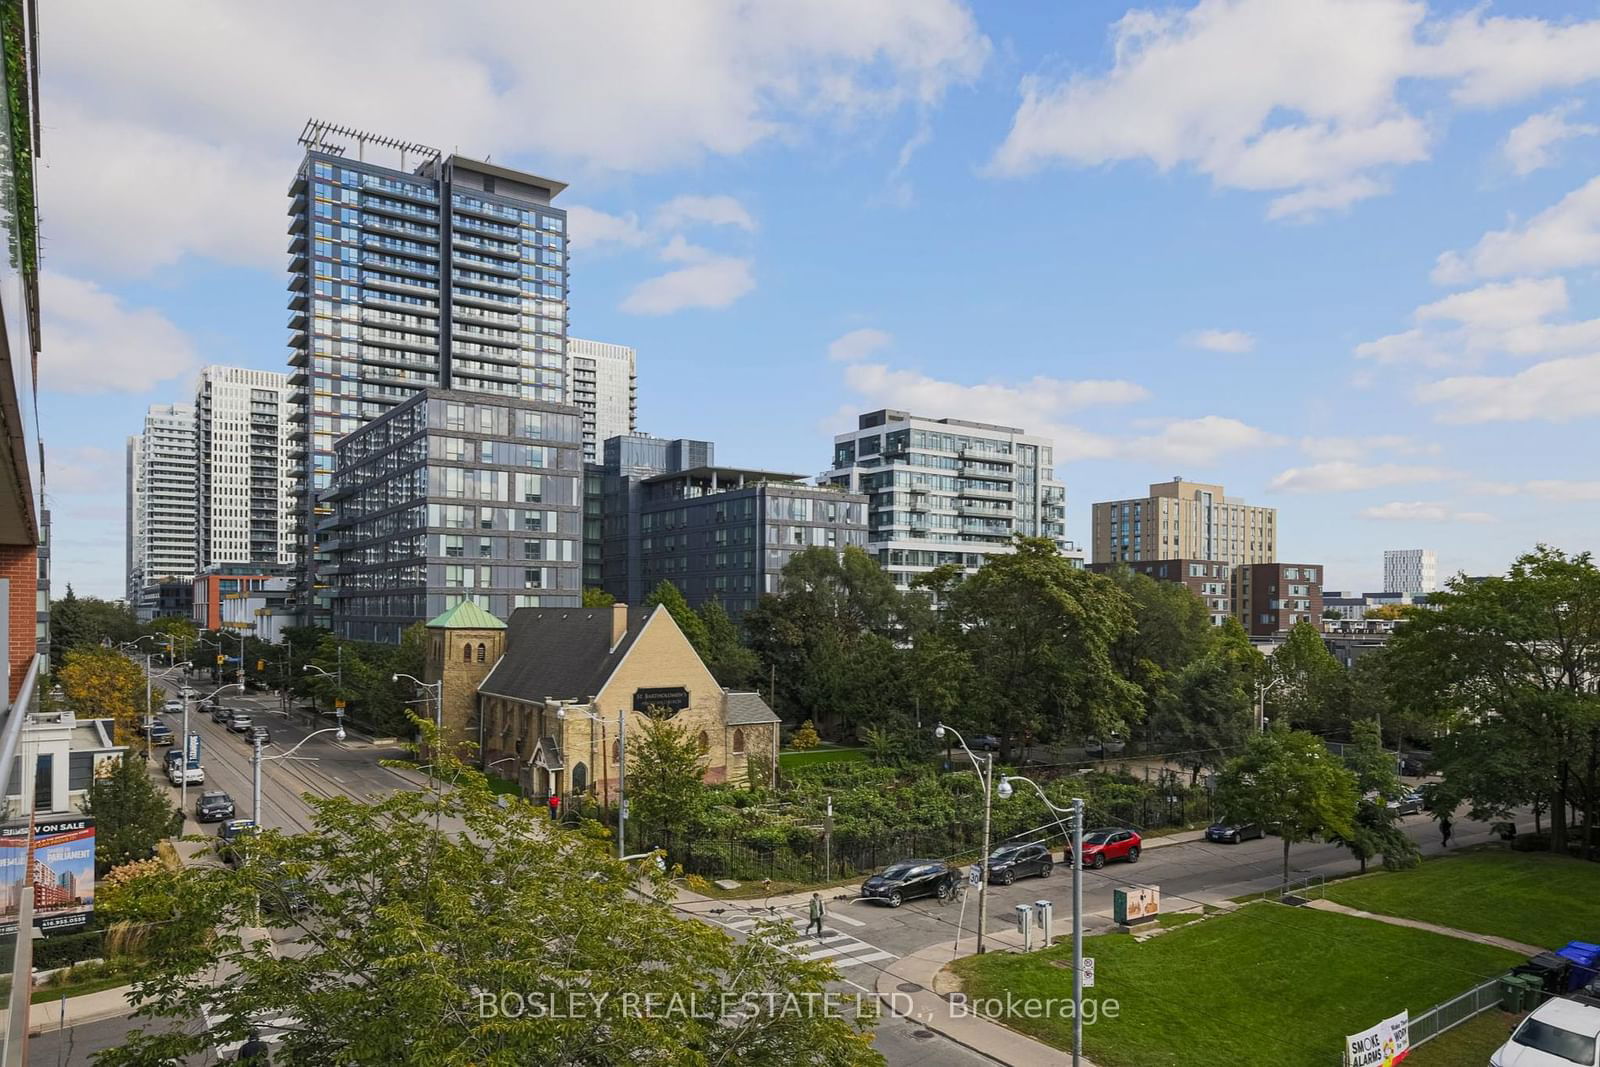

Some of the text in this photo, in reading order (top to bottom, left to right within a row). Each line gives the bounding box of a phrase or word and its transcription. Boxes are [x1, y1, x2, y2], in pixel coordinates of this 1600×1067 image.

[42, 824, 58, 832] ON
[60, 822, 85, 831] SALE
[47, 849, 90, 862] PARLIAMENT
[970, 872, 978, 884] 30
[1352, 1034, 1380, 1054] SMOKE
[1353, 1048, 1382, 1067] ALARMS
